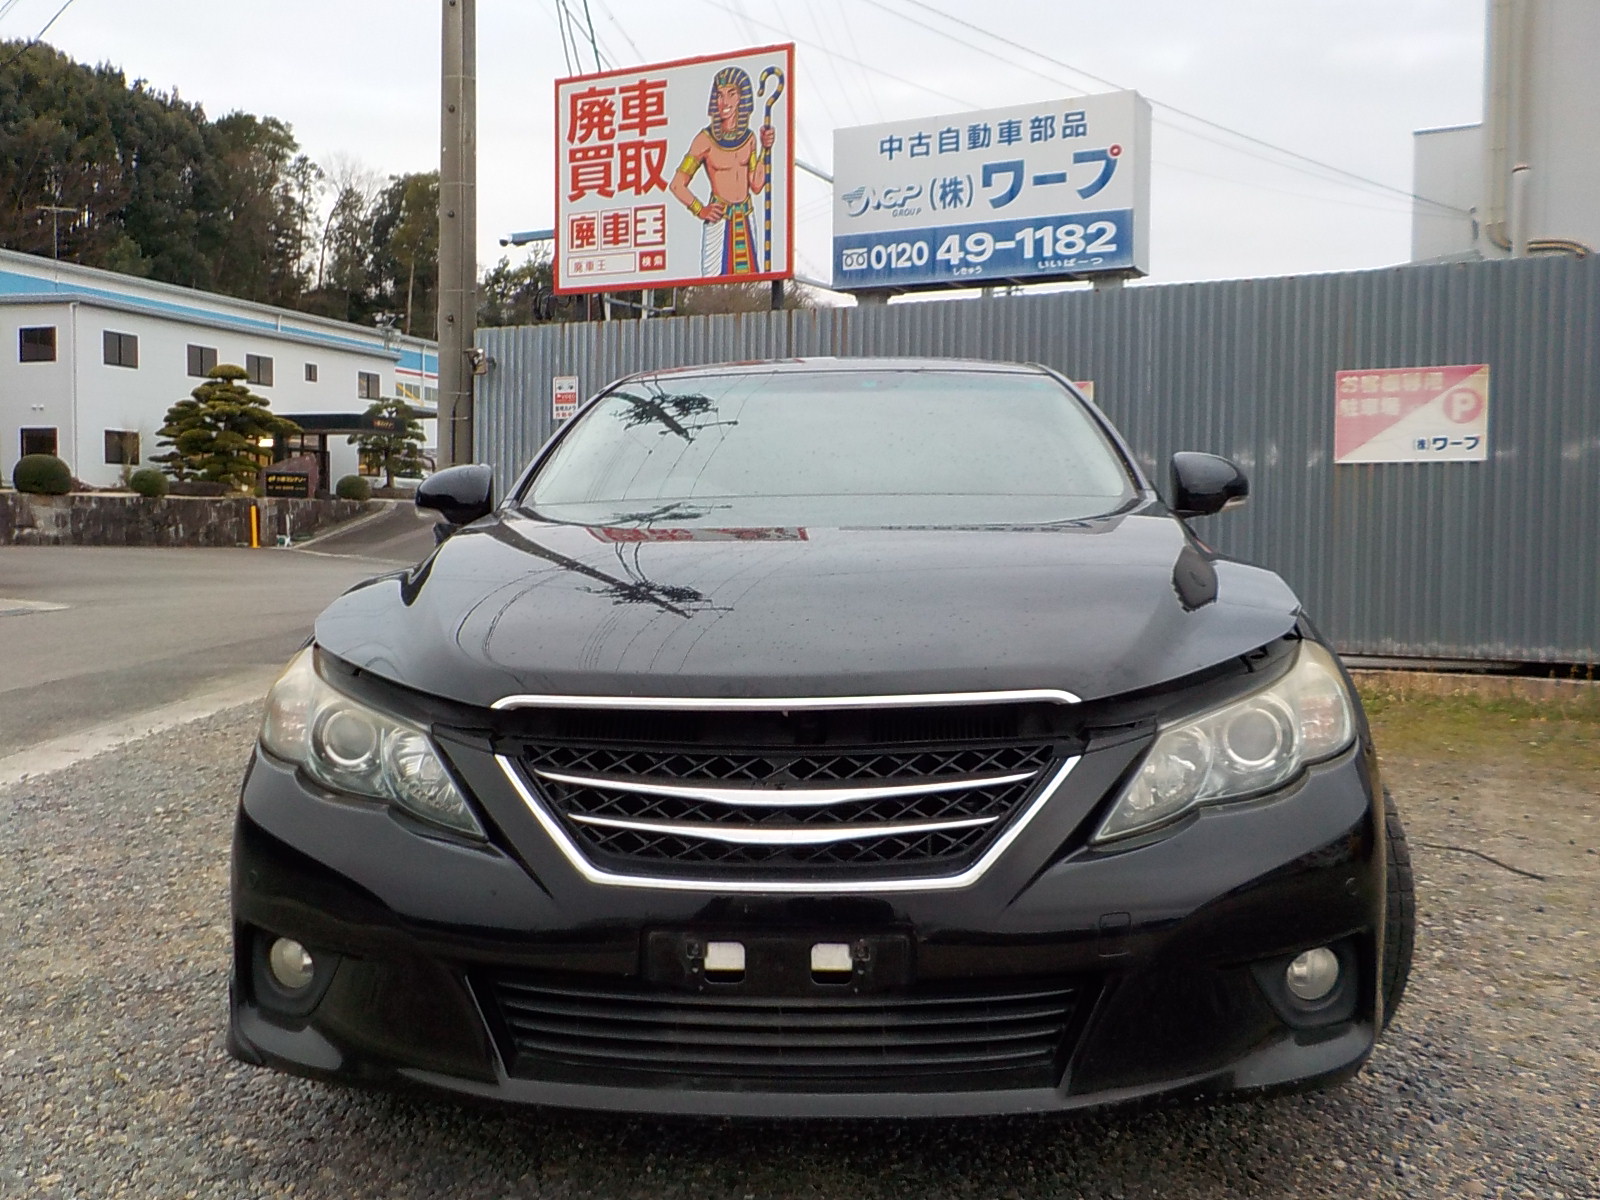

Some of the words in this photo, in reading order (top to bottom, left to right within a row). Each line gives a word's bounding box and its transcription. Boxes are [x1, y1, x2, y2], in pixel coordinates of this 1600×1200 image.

[567, 79, 668, 145] 廃車
[880, 110, 1087, 160] 中古自動車部品
[568, 139, 668, 203] 買取
[870, 241, 930, 270] 0120
[937, 221, 1117, 265] 49-1182
[1453, 392, 1476, 420] P
